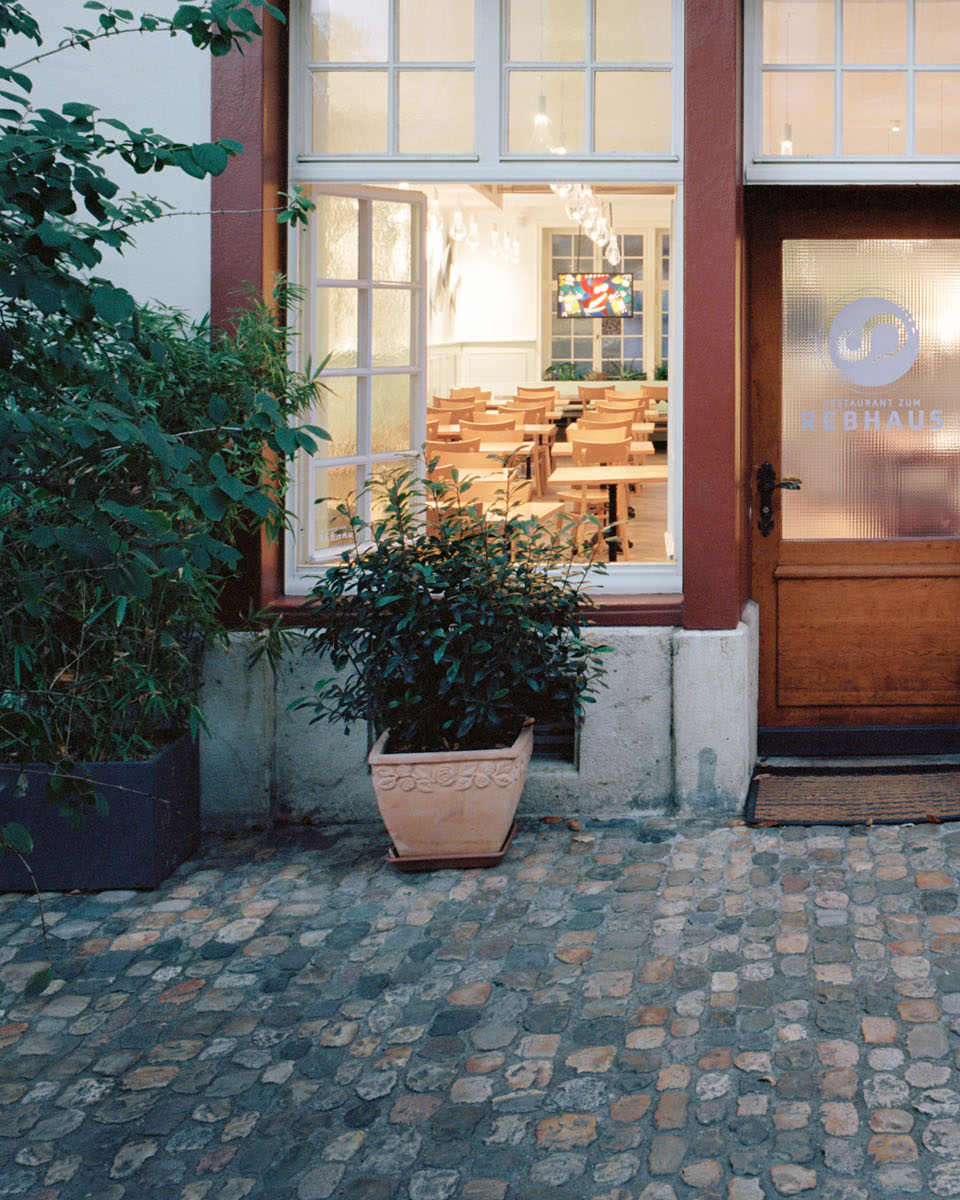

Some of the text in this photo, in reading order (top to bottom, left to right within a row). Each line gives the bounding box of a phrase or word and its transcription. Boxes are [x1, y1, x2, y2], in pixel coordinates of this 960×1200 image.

[824, 398, 921, 408] RESTAURANT ZUM
[801, 410, 945, 431] REBHAUS
